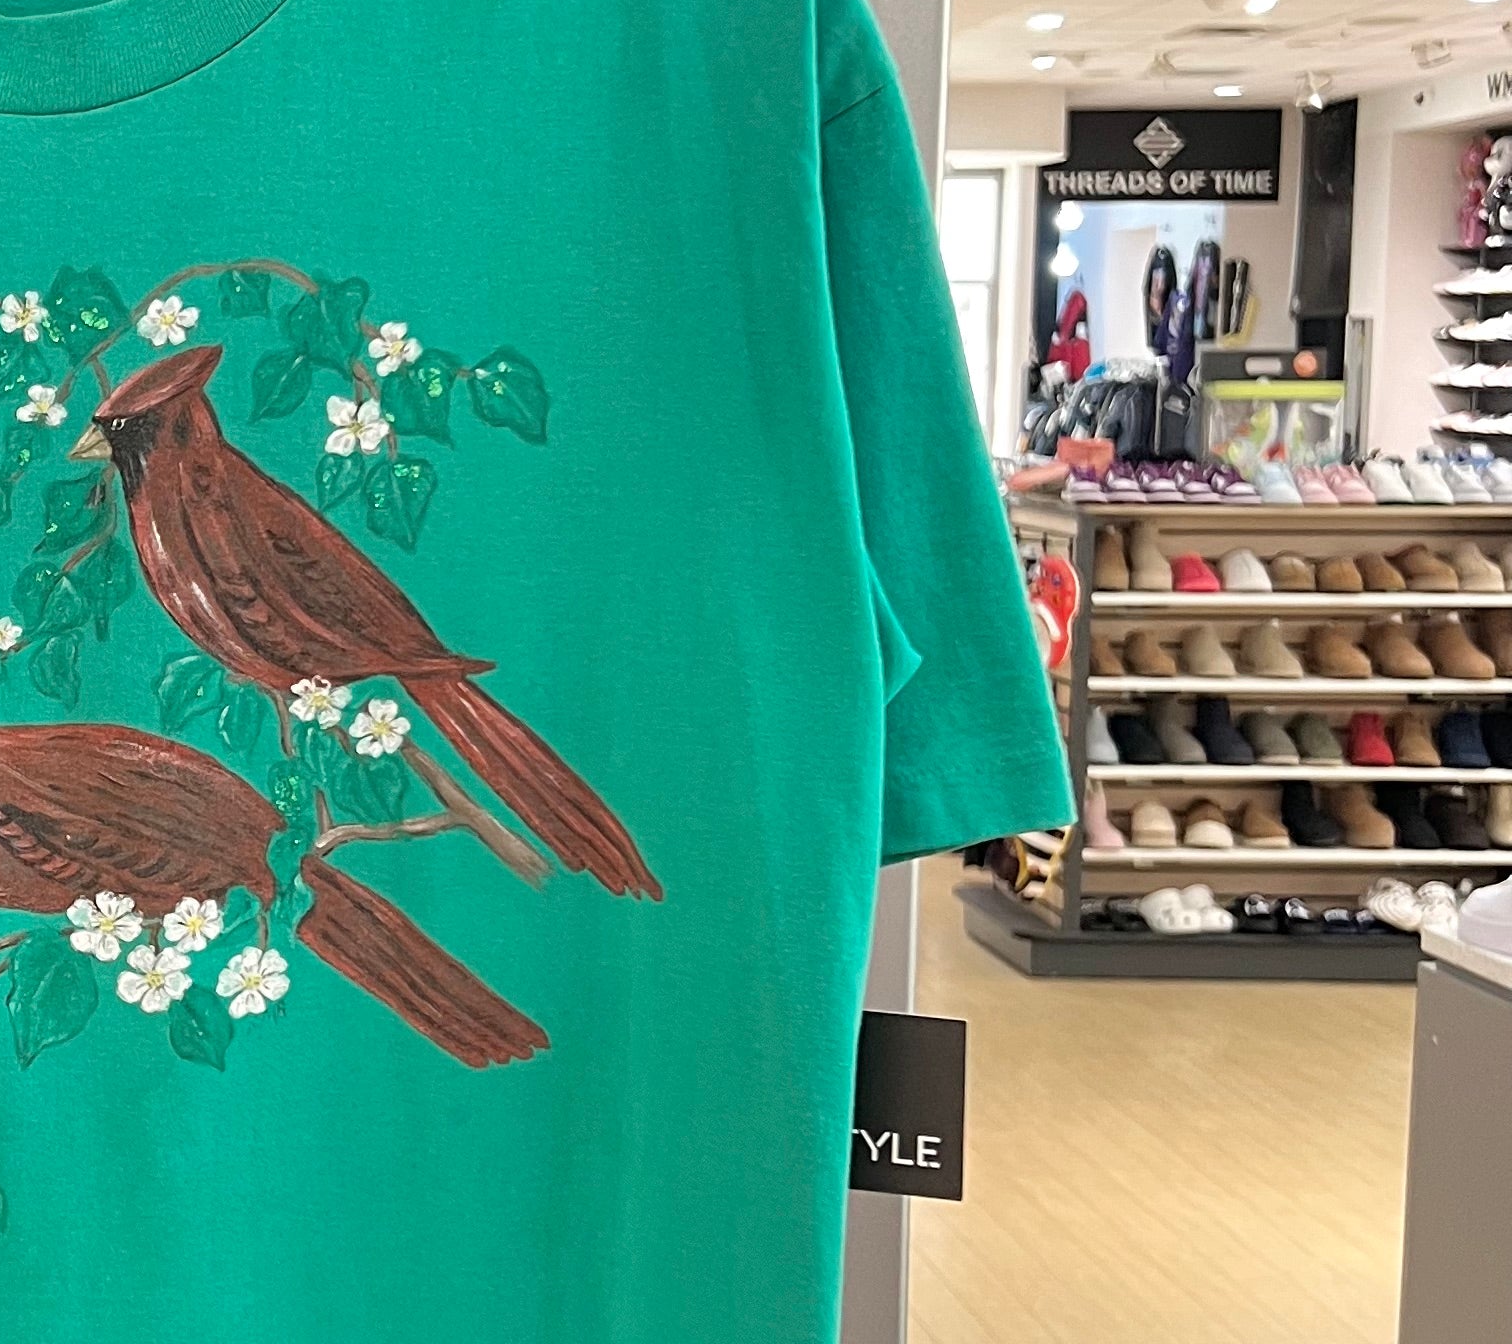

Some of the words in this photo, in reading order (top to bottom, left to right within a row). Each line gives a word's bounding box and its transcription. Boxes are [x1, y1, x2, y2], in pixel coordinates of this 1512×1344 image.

[1043, 170, 1165, 196] THREADS
[1169, 170, 1207, 195] OF
[1210, 169, 1273, 195] TIME
[851, 1128, 942, 1169] YLE
